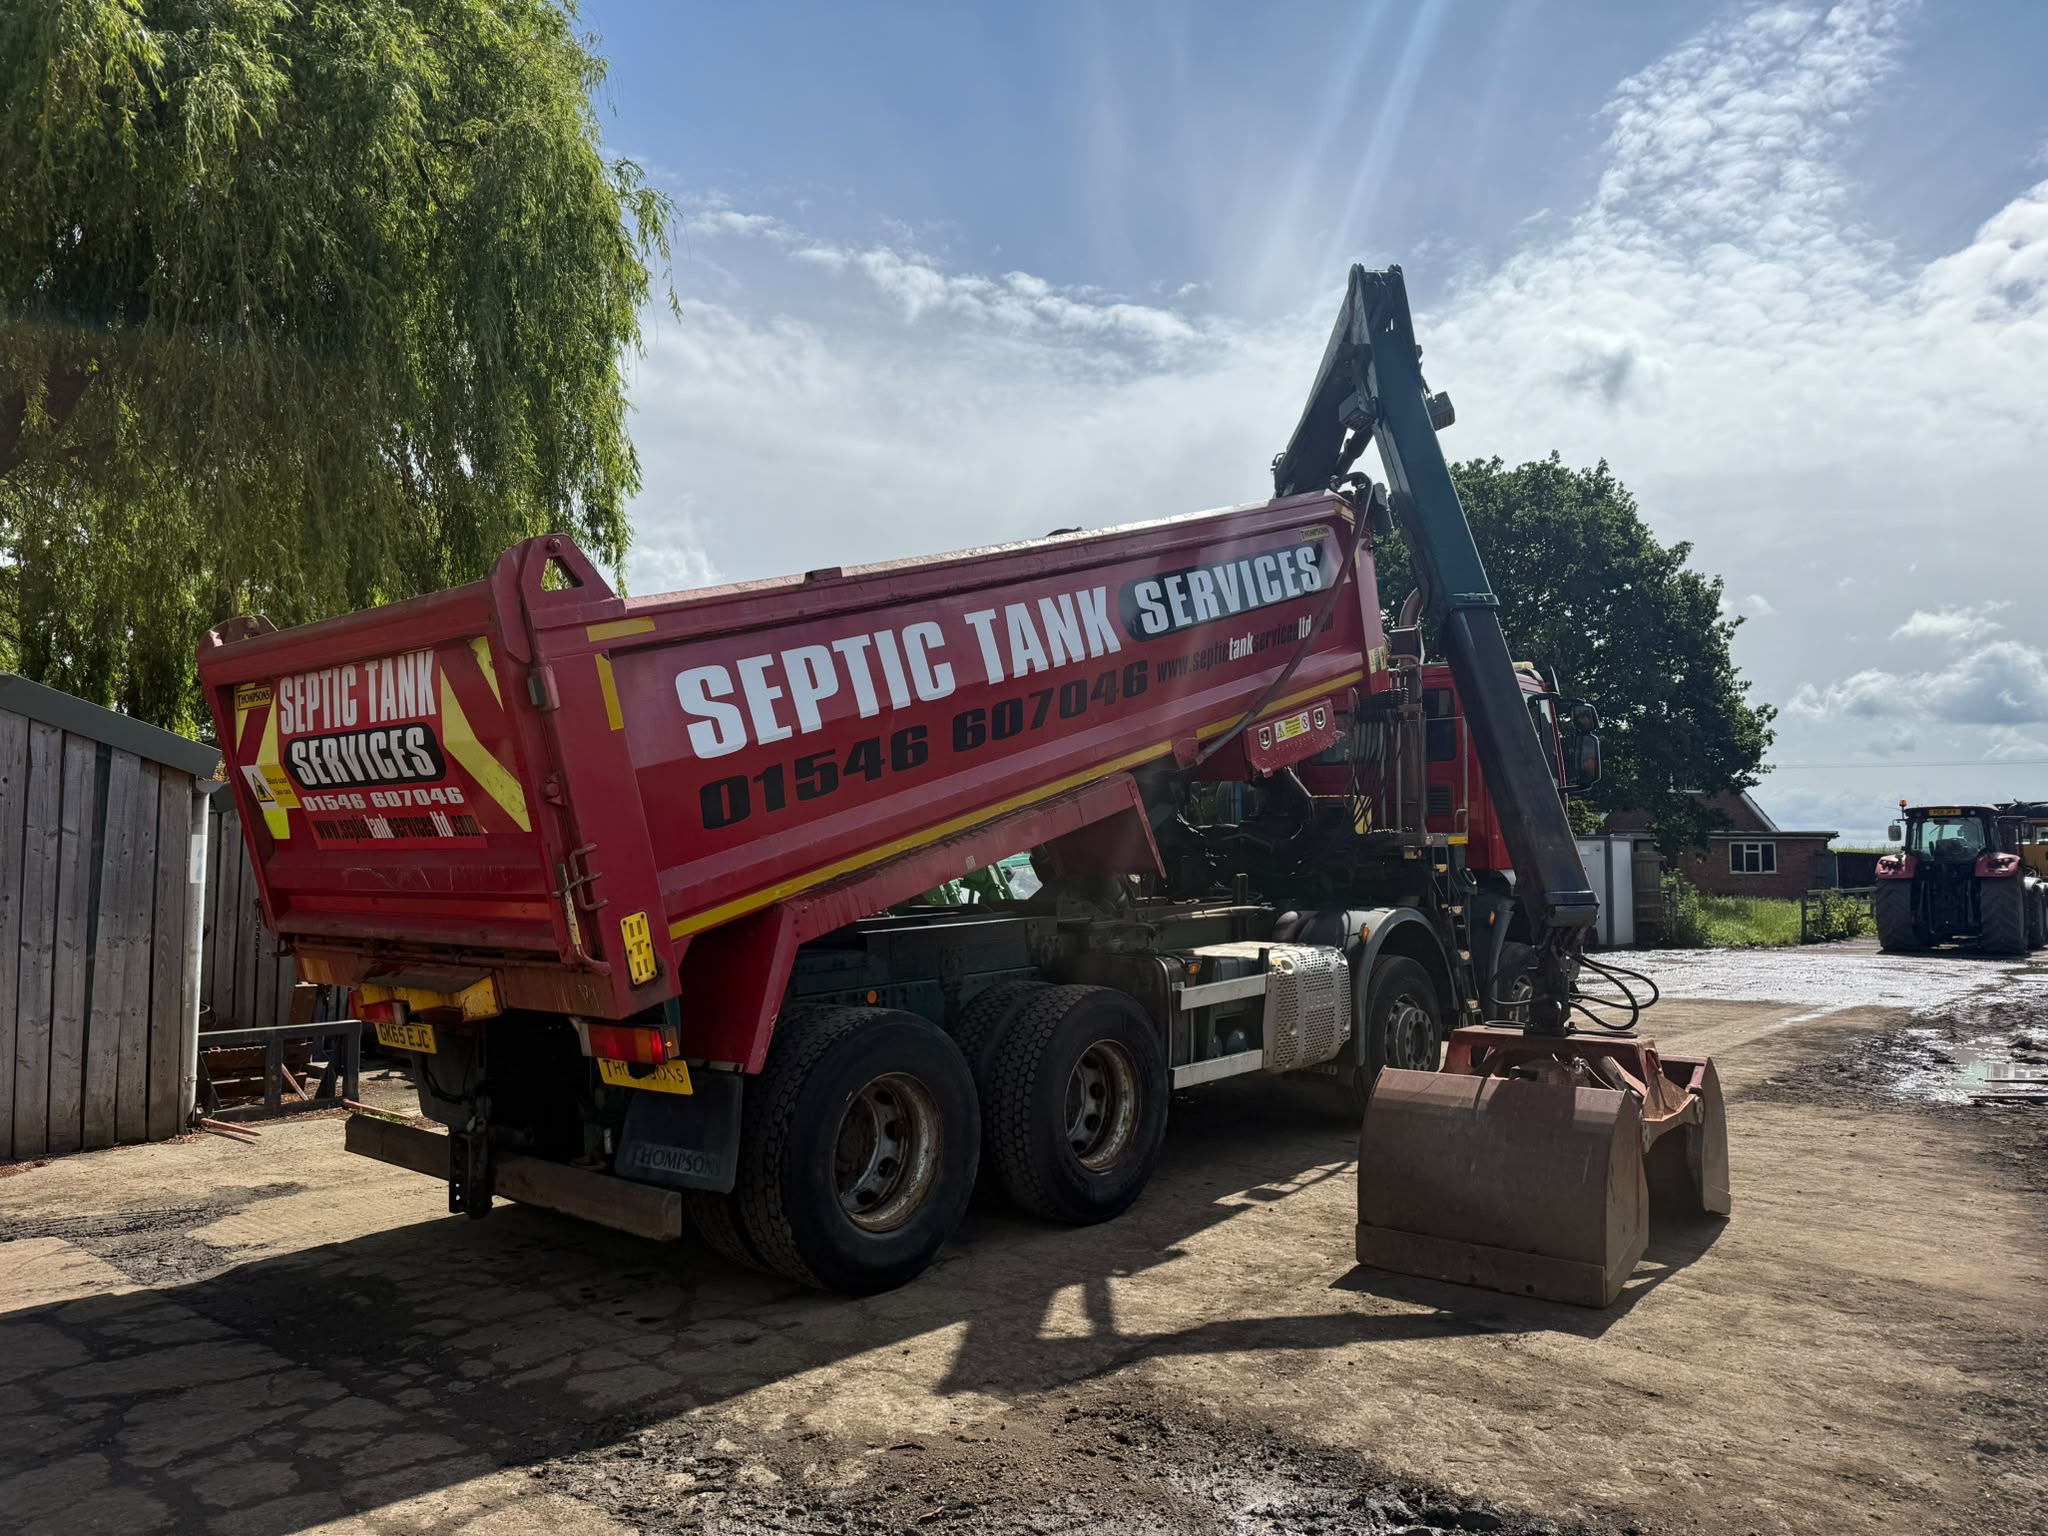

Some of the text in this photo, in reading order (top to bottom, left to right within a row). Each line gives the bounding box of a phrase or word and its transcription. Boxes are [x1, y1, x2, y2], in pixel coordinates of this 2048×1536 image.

[675, 546, 1322, 759] SEPTIC TANK SERVICES
[238, 690, 270, 707] THOMPSONS
[280, 650, 437, 735] SEPTIC TANK
[291, 727, 437, 786] SERVICES
[700, 660, 1148, 829] 01546 607046
[302, 787, 465, 811] 01546 607046
[1303, 993, 1335, 1010] IVECO
[406, 1027, 430, 1048] EJC
[603, 1059, 684, 1083] THOONS
